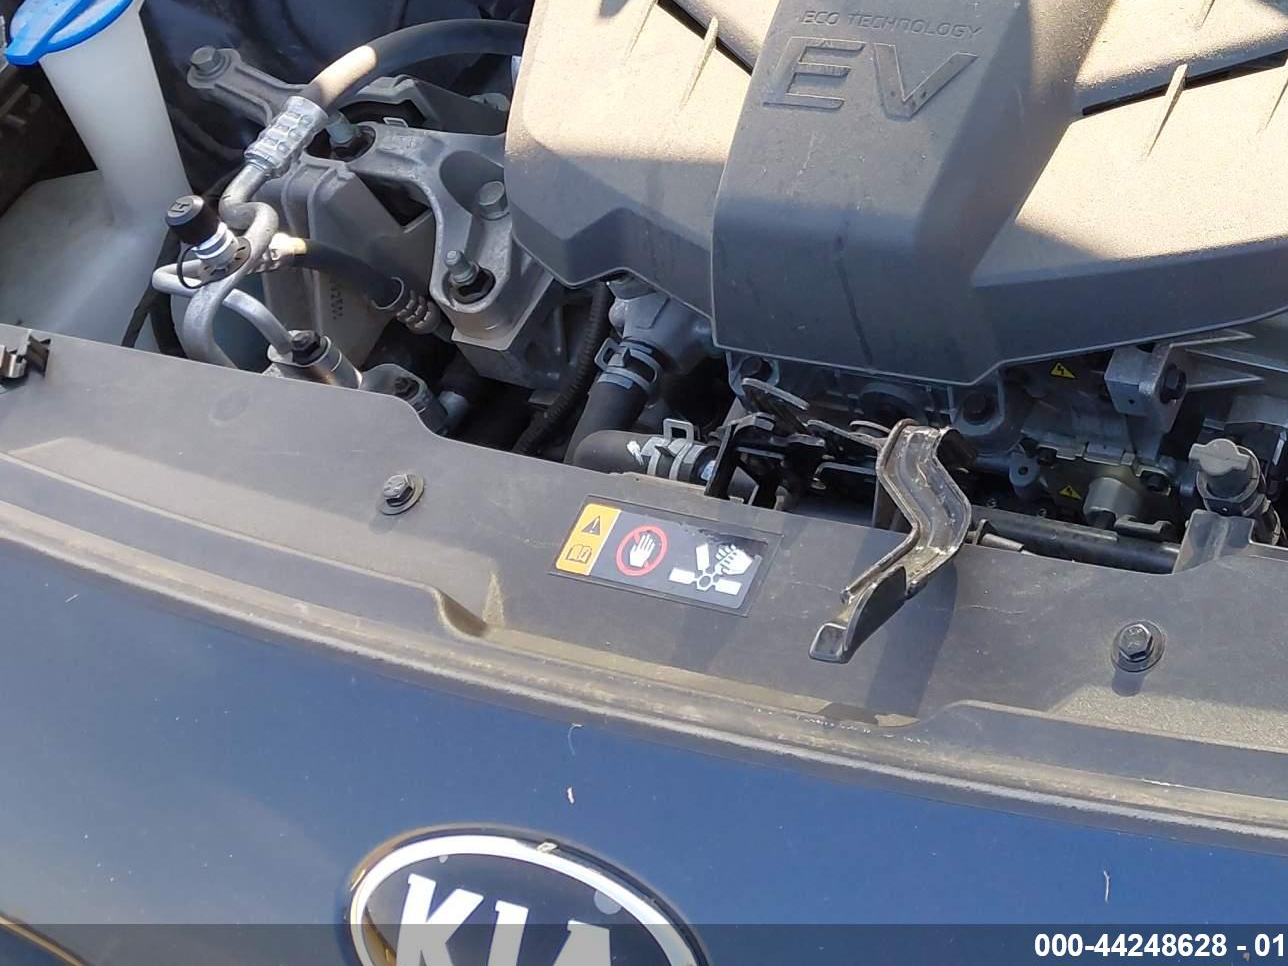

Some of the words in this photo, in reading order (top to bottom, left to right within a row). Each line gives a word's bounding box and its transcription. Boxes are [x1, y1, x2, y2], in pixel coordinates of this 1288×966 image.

[801, 10, 840, 26] ECO
[849, 12, 982, 38] TECHNOLOGY
[763, 36, 979, 121] EV
